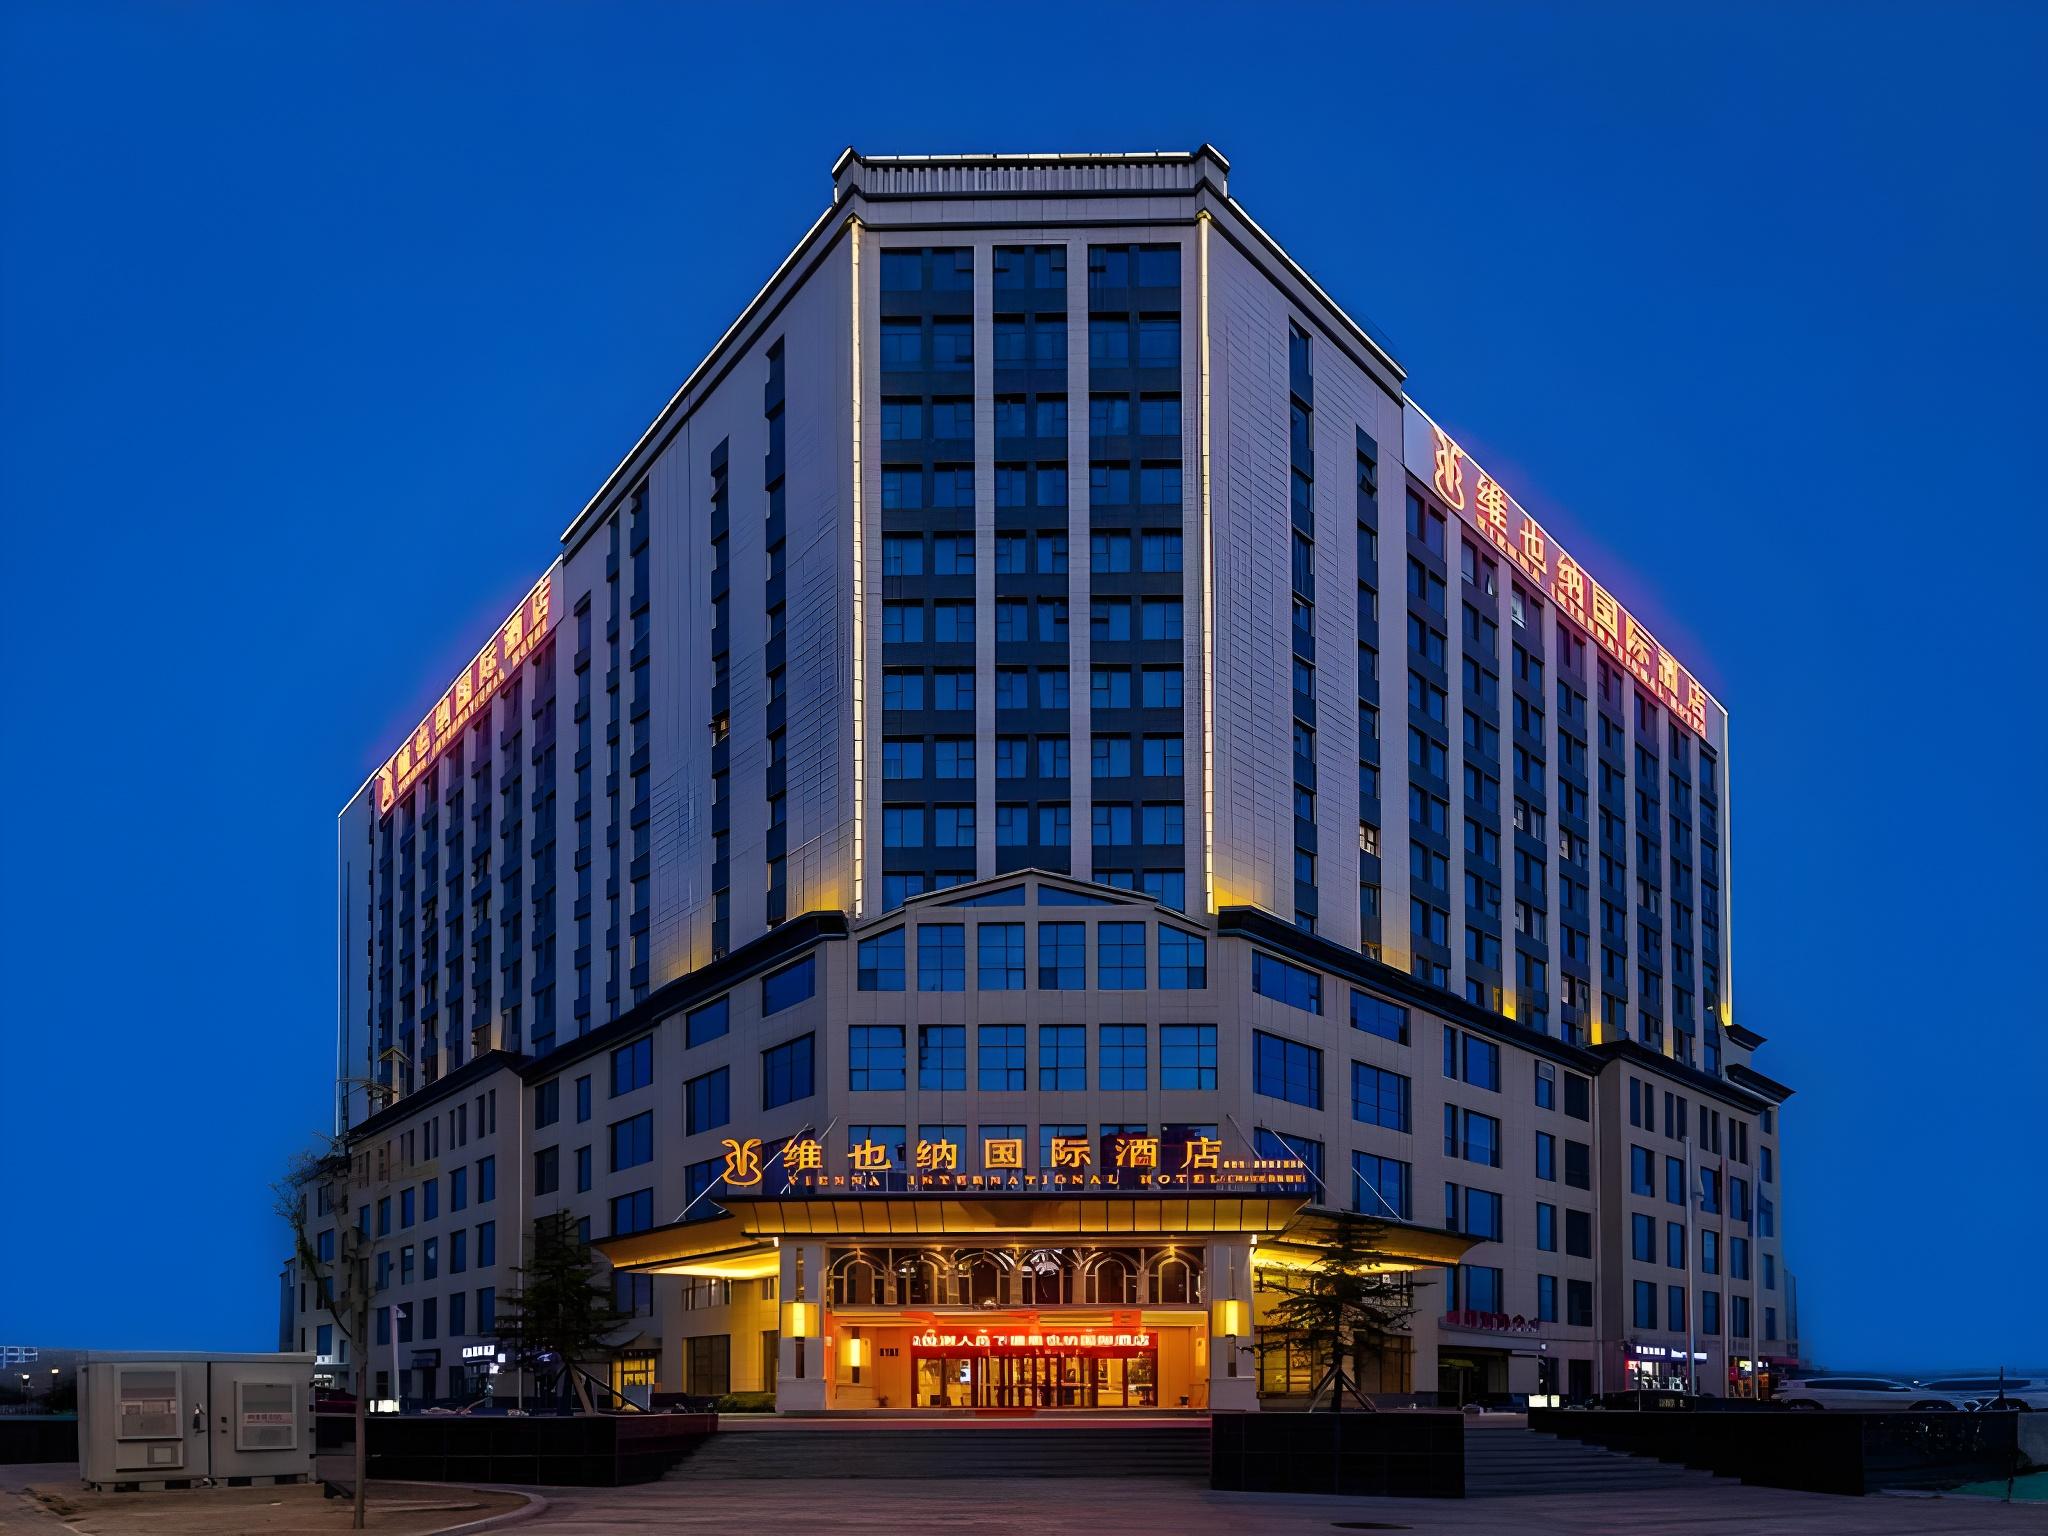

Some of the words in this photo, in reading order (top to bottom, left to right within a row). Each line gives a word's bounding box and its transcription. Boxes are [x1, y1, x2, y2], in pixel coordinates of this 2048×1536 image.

[782, 1137, 1223, 1170] 维也纳国际酒店
